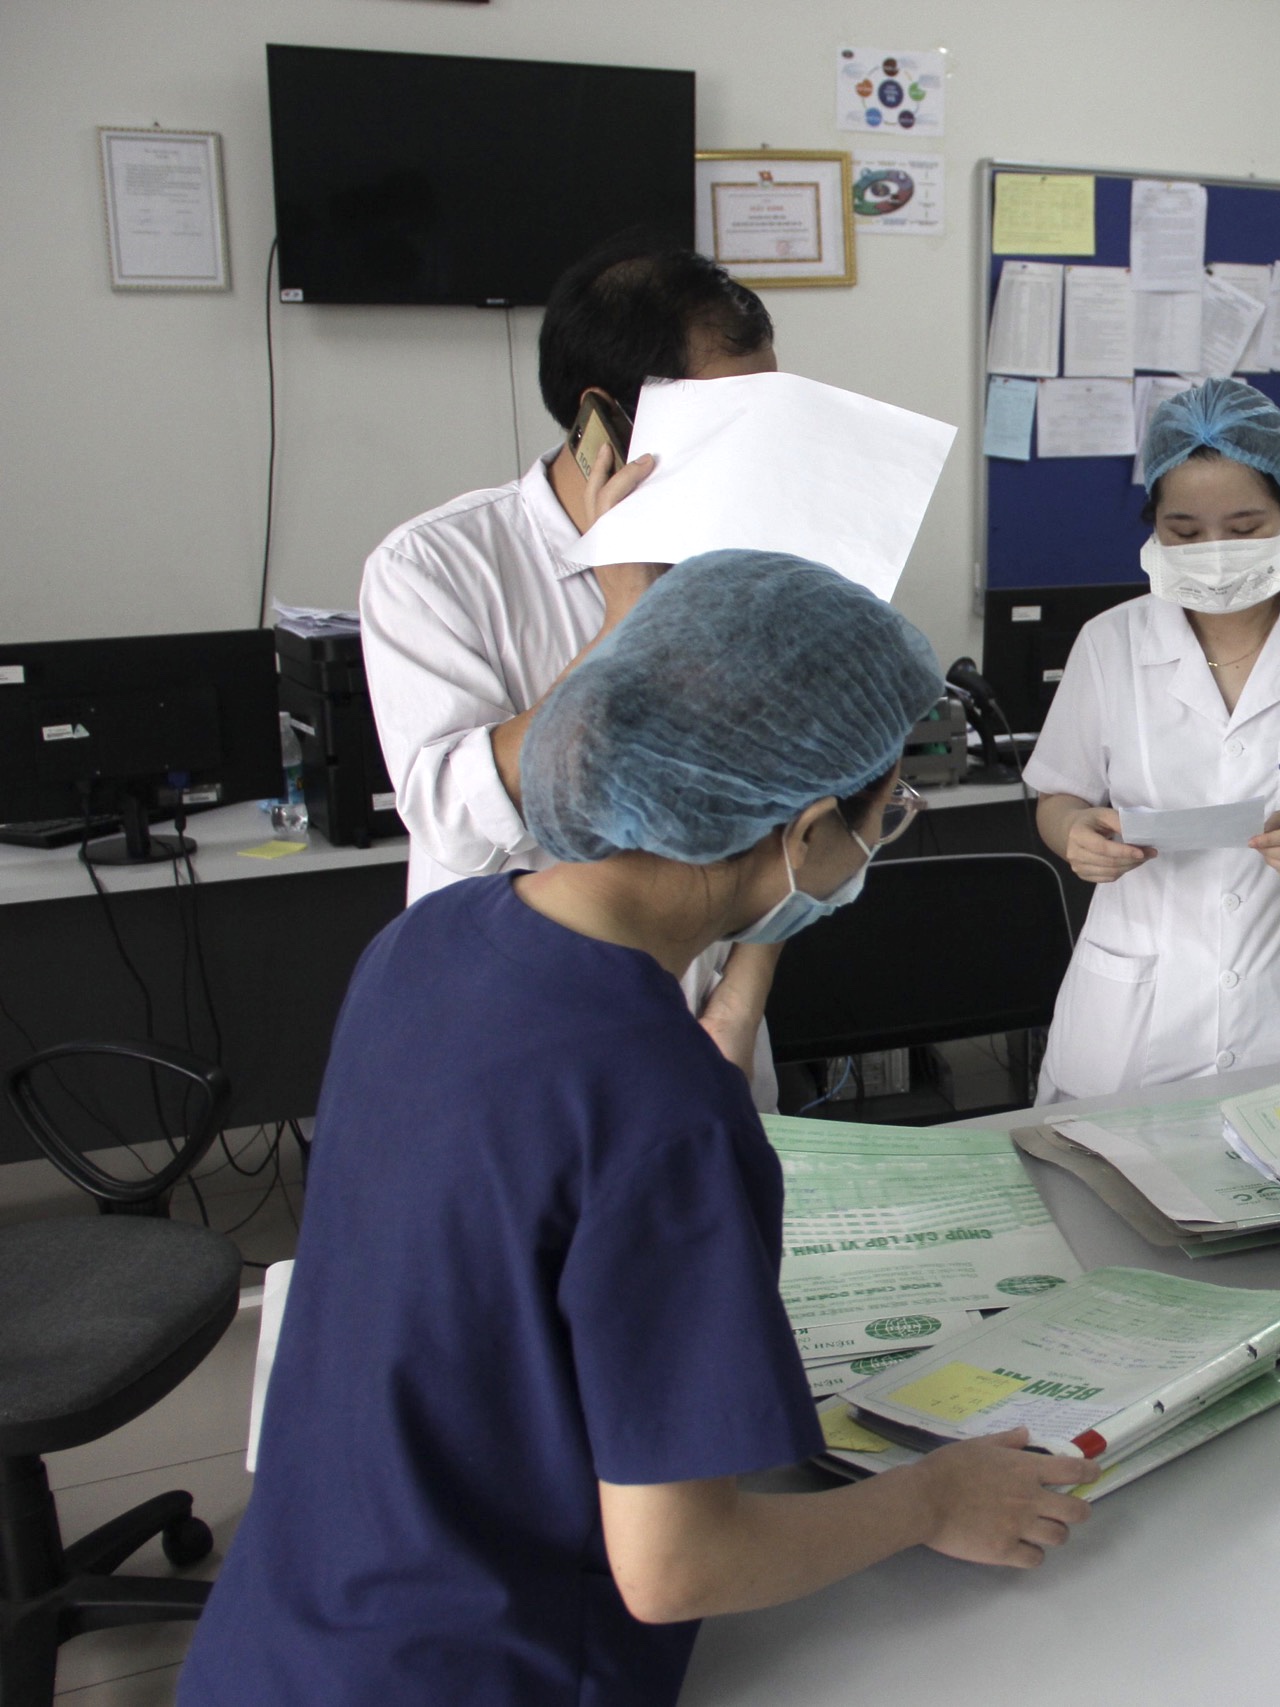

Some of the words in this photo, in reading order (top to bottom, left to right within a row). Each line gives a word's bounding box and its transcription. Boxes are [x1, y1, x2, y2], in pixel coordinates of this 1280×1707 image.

[904, 1232, 938, 1245] CẮT
[945, 1228, 992, 1241] CHỤP
[1021, 1380, 1104, 1401] BỆNH
